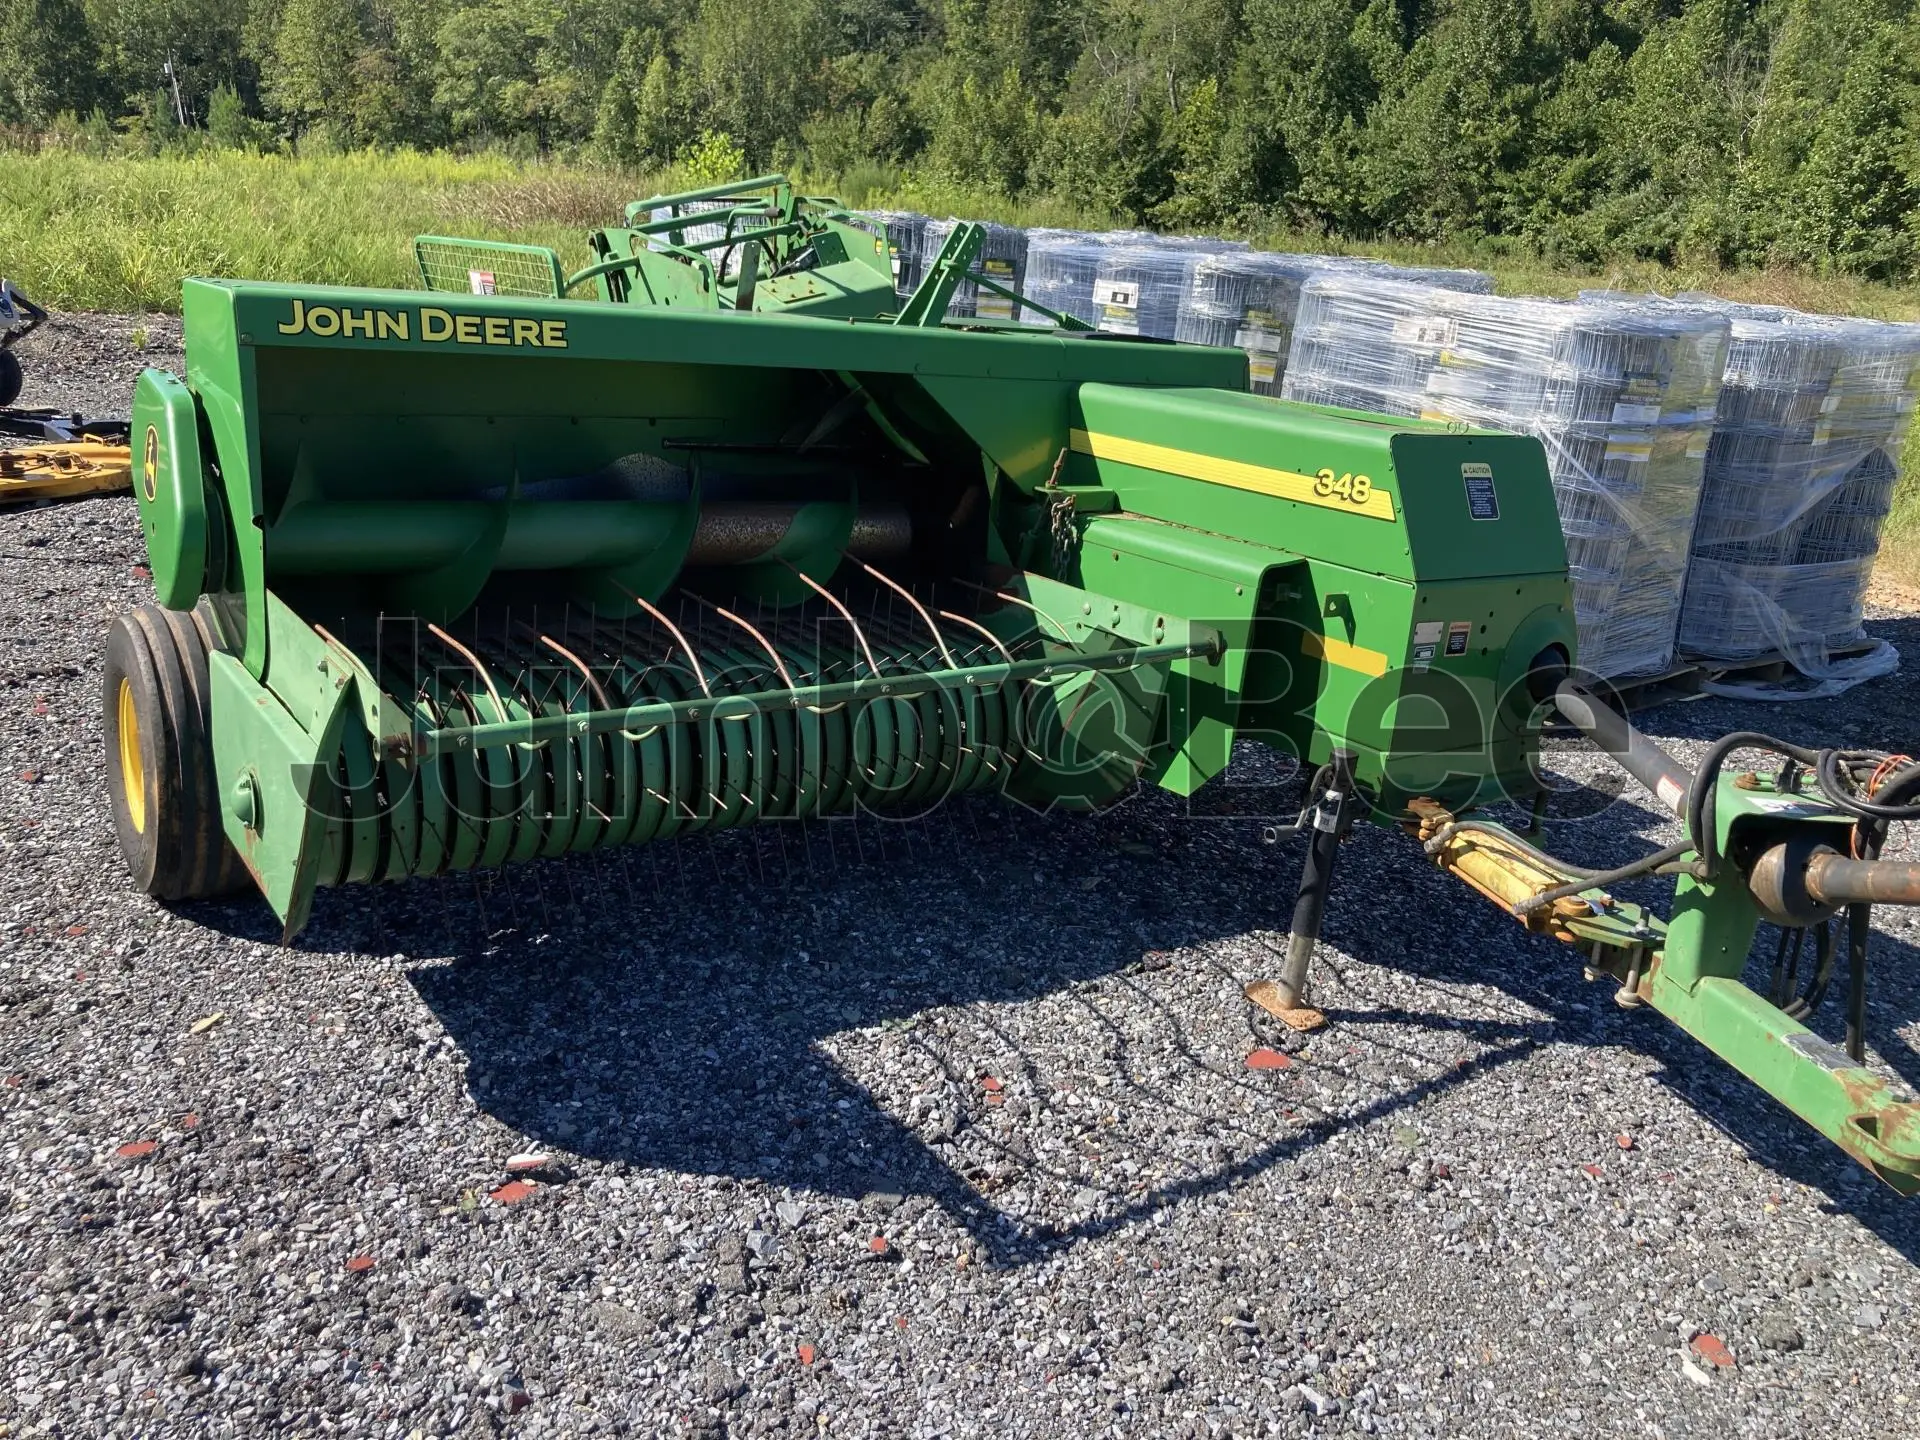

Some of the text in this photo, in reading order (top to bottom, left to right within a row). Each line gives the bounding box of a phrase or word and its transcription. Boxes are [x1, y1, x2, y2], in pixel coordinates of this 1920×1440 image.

[277, 298, 569, 349] JOHN DEERE
[1313, 468, 1371, 504] 348
